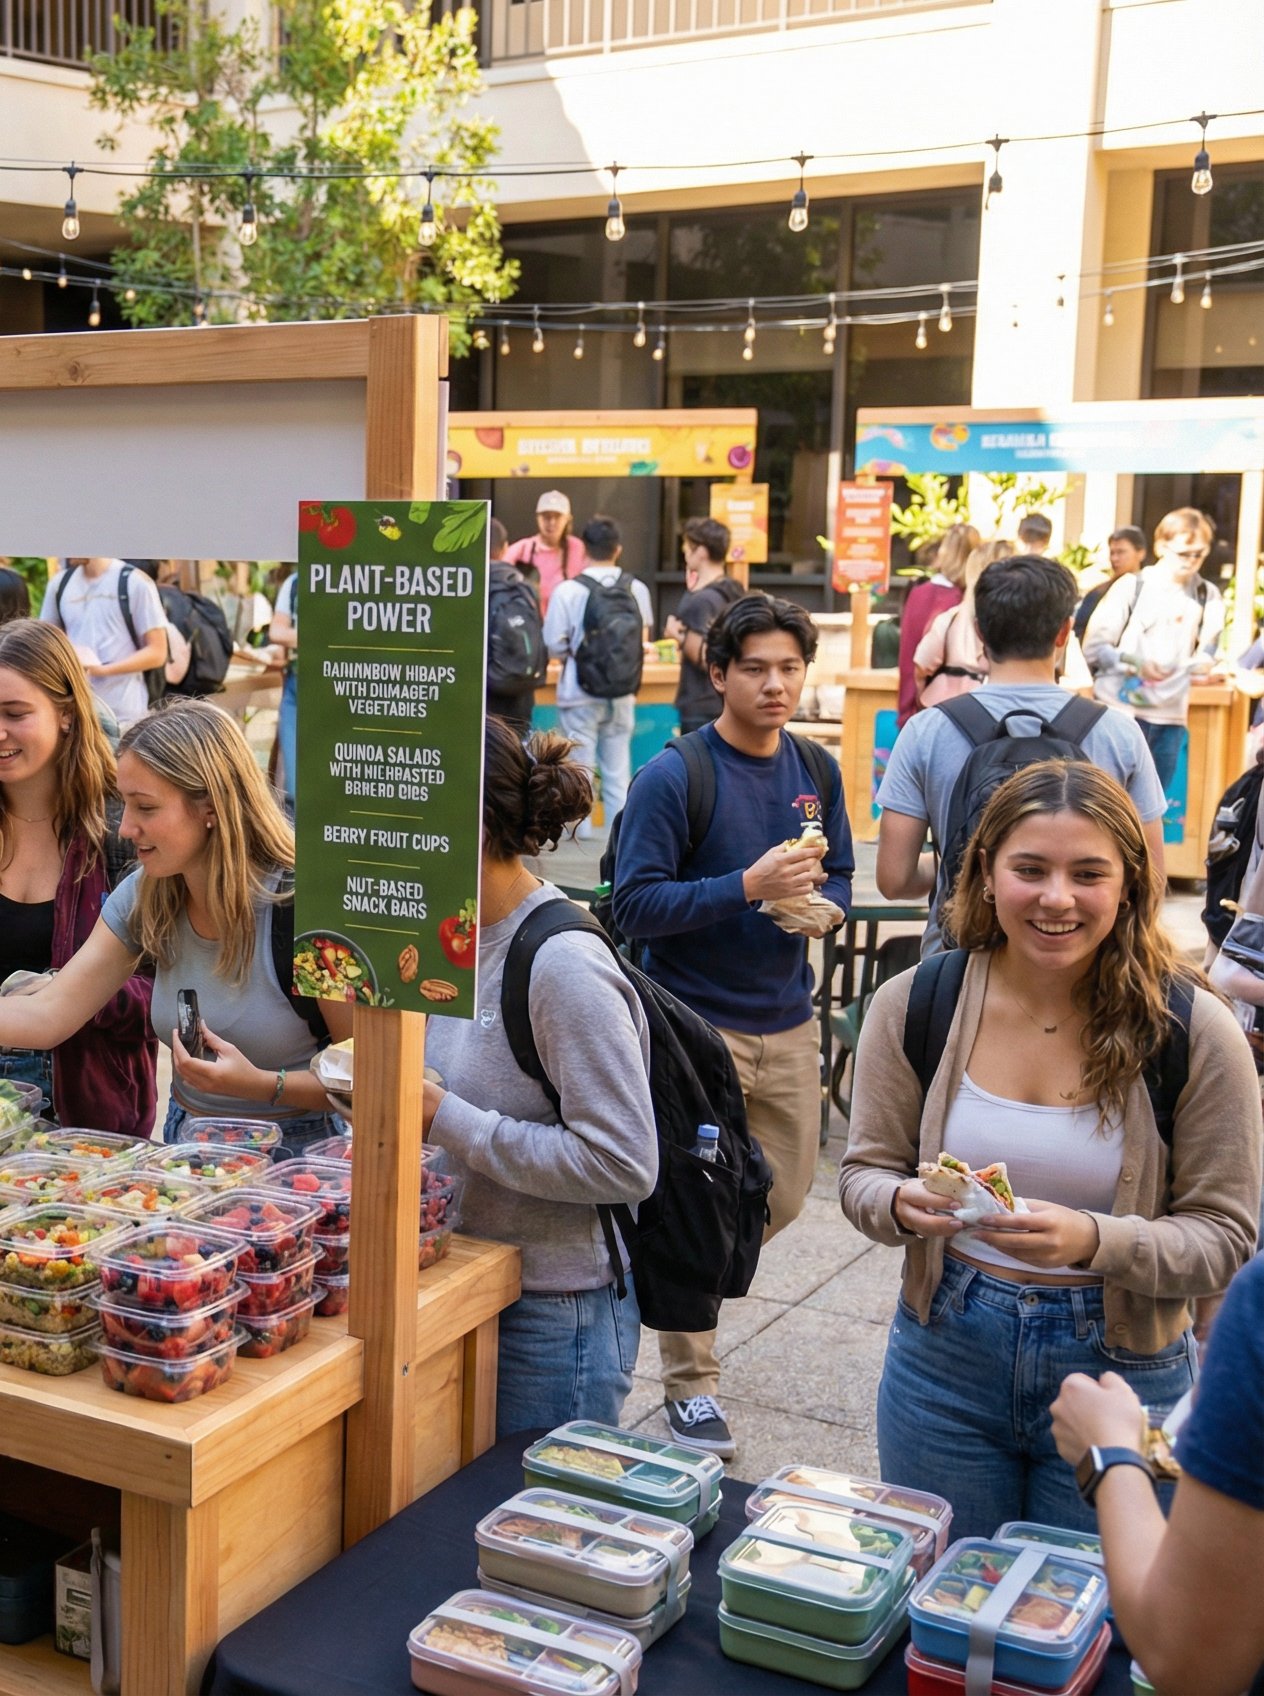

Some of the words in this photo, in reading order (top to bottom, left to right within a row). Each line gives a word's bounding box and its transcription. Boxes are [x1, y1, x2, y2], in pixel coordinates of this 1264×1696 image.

[310, 564, 472, 597] PLANT-BASED
[348, 601, 431, 633] POWER
[334, 680, 367, 697] WITH
[334, 742, 384, 763] QUINOA
[387, 746, 441, 766] SALADS
[329, 761, 361, 778] WITH
[323, 825, 367, 846] BERRY
[370, 829, 409, 849] FRUIT
[412, 834, 449, 853] CUPS
[347, 875, 423, 900] NUT-BASED
[343, 894, 388, 915] SNACK
[390, 899, 427, 920] BARS
